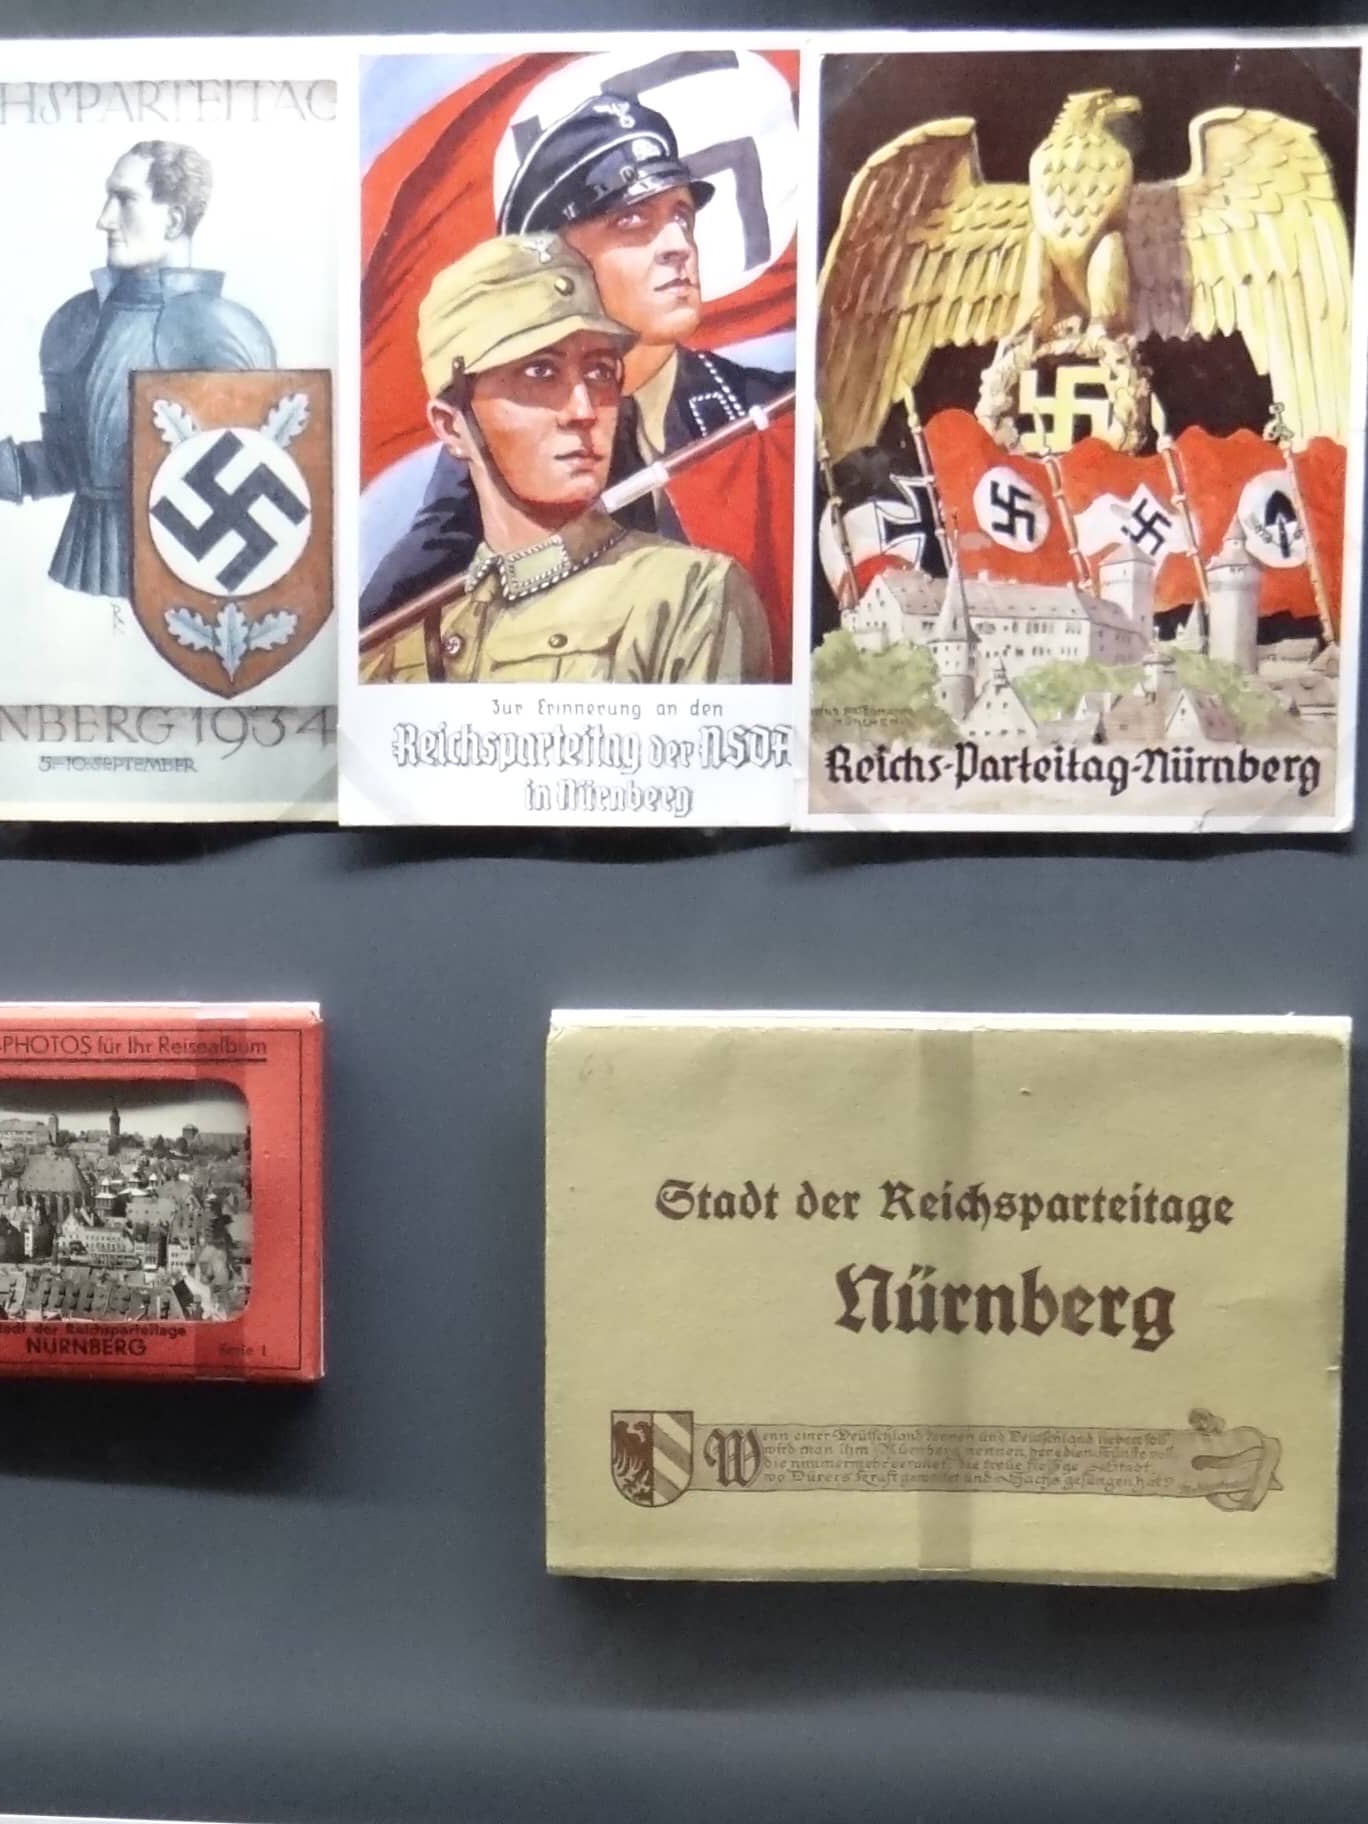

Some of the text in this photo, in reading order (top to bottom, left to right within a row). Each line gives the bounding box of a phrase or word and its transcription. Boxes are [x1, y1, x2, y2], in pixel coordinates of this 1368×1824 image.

[538, 698, 642, 720] Erinnerung
[656, 704, 677, 717] an
[690, 698, 724, 717] den
[192, 704, 337, 760] 1934
[648, 728, 694, 769] der
[524, 778, 695, 818] in Nürnberg
[127, 1035, 154, 1056] Ihr
[655, 1178, 1235, 1234] Stadt der Reichsparteitage
[833, 1261, 1177, 1353] Nürnberg
